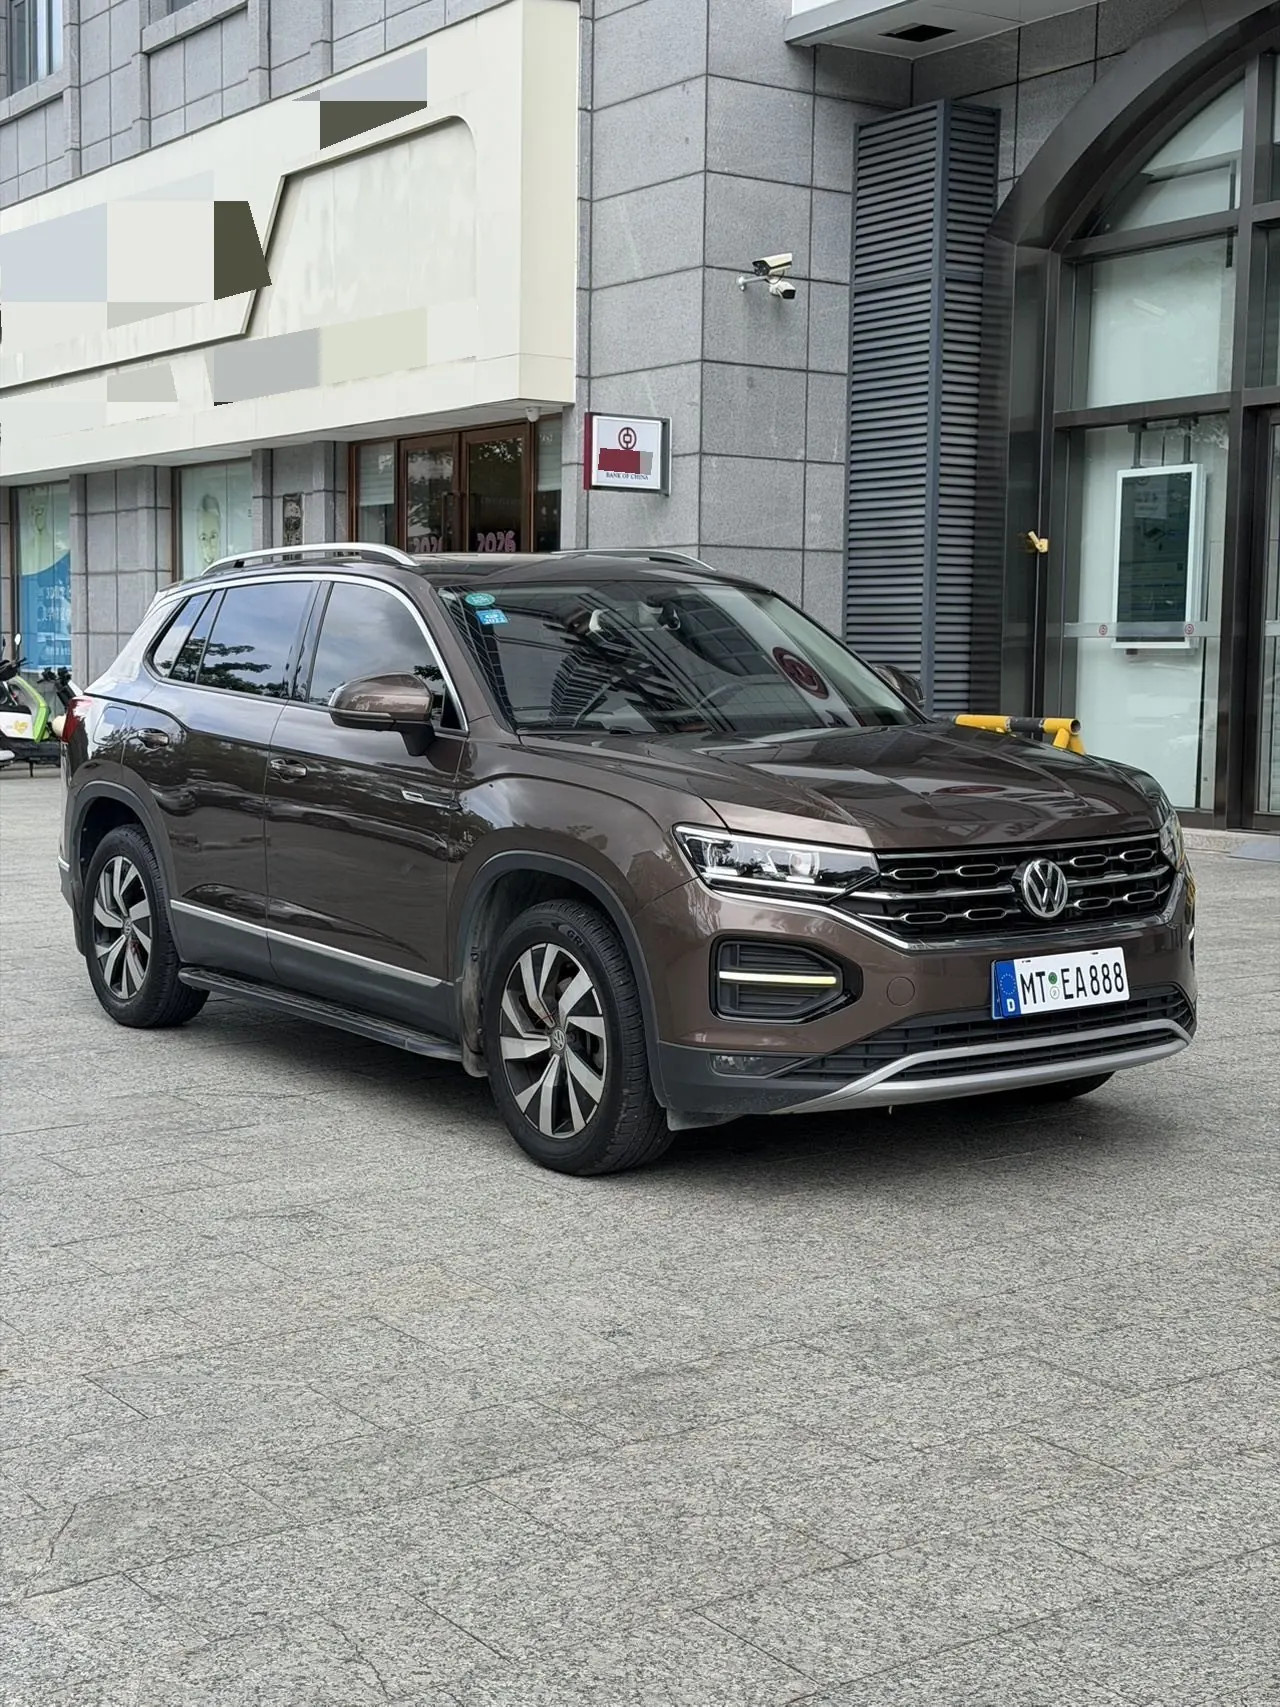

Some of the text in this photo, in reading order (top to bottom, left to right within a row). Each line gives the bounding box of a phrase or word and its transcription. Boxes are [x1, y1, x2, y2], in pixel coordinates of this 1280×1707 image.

[477, 530, 516, 553] 2026
[1020, 962, 1124, 1005] MT EA888
[1006, 998, 1016, 1012] D
